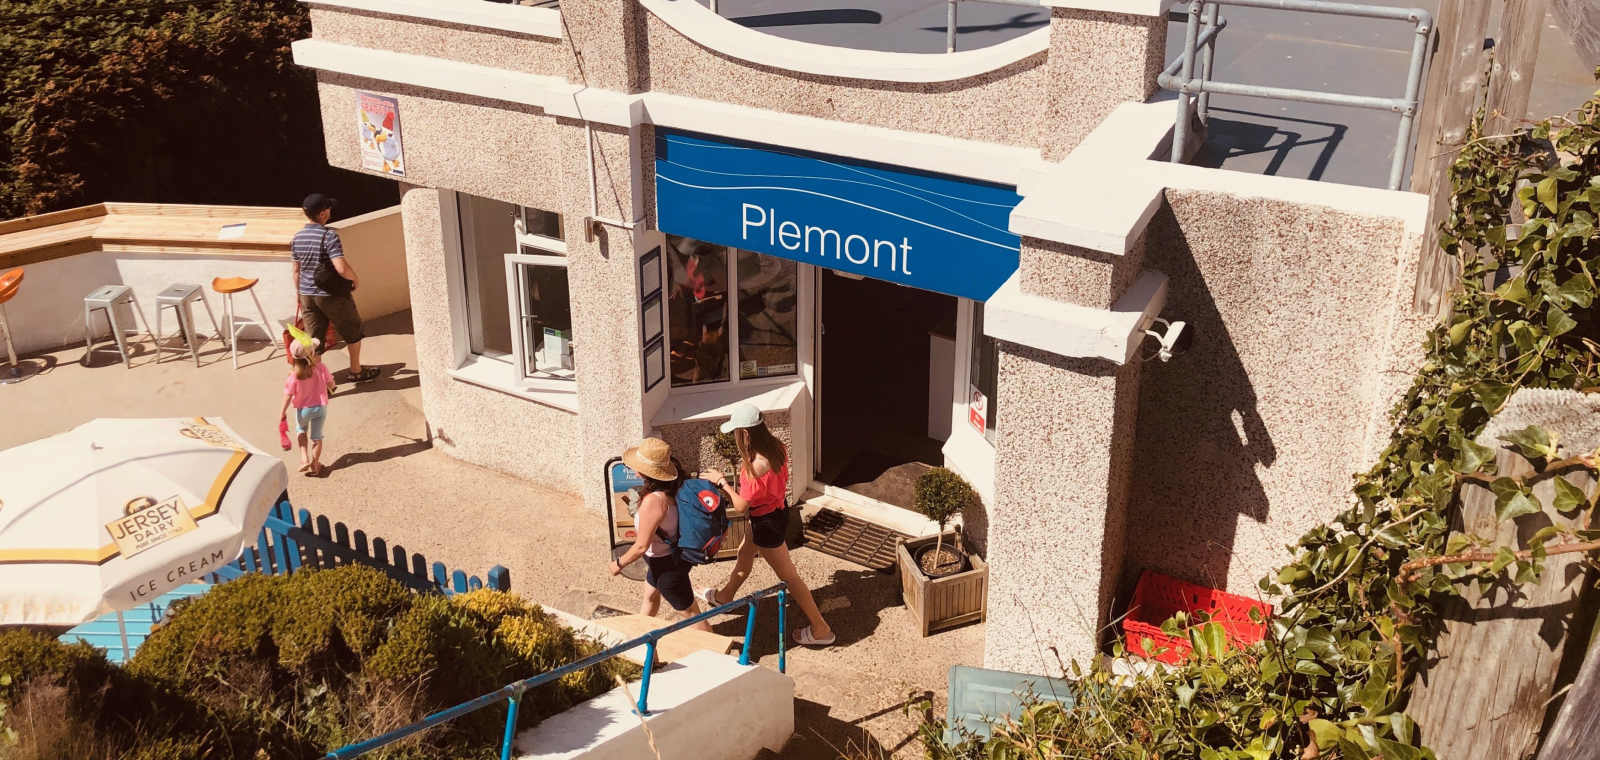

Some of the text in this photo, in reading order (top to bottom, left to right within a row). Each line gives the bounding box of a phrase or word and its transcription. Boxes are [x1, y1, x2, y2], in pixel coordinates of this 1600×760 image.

[742, 202, 913, 275] Plemont
[116, 500, 180, 540] JERSEY
[134, 519, 176, 543] DAIRY
[129, 549, 225, 602] ICE CREAM
